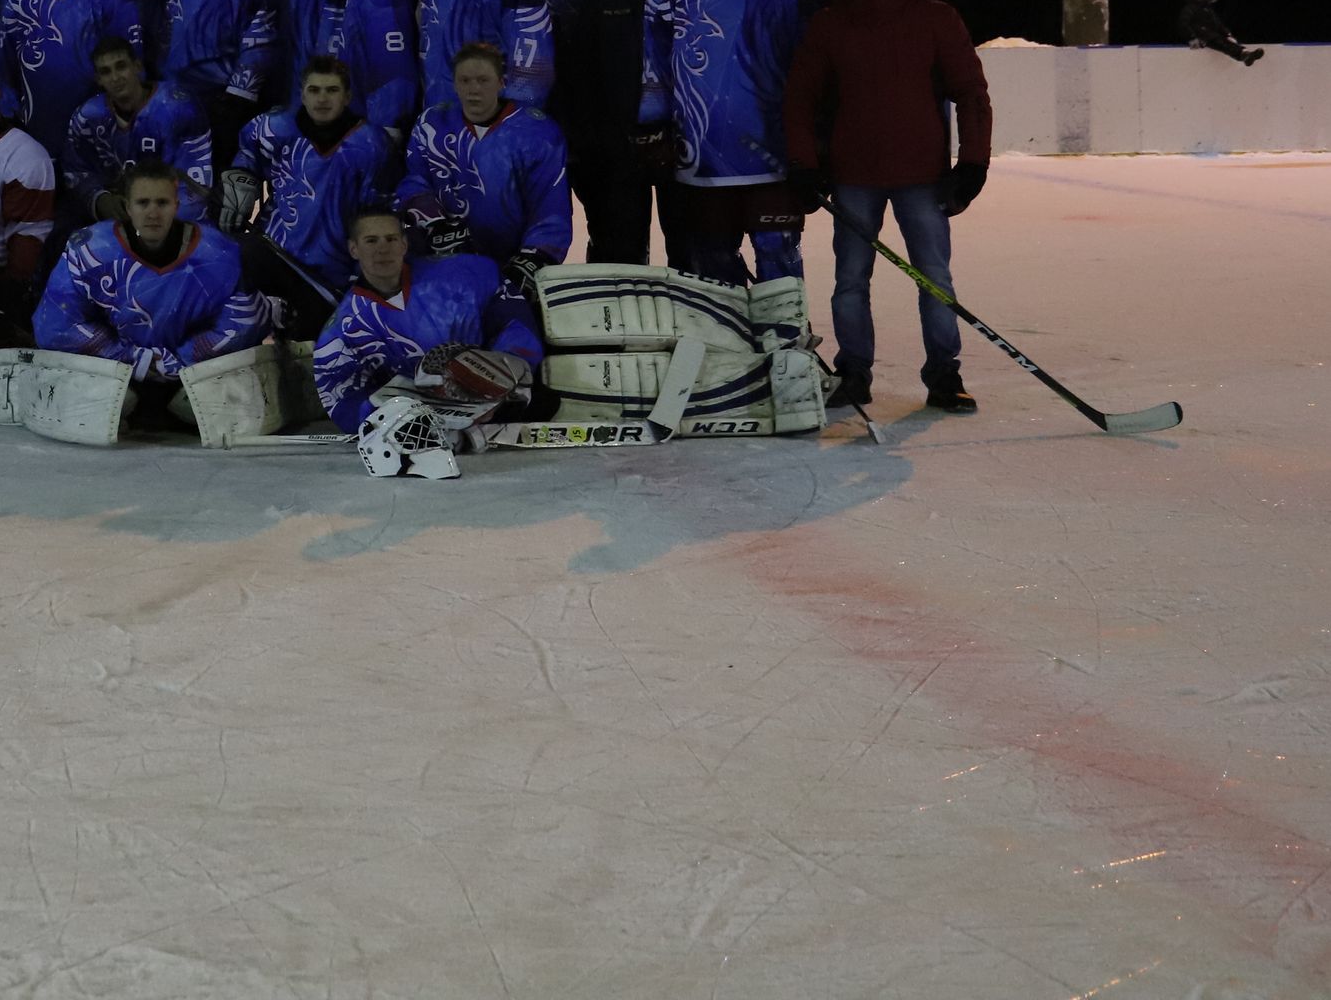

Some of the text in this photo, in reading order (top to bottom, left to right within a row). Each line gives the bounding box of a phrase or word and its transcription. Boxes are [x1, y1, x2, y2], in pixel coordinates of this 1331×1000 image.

[385, 31, 405, 51] 8
[513, 38, 537, 68] 47
[973, 320, 1038, 373] CCM
[691, 421, 760, 434] CCM
